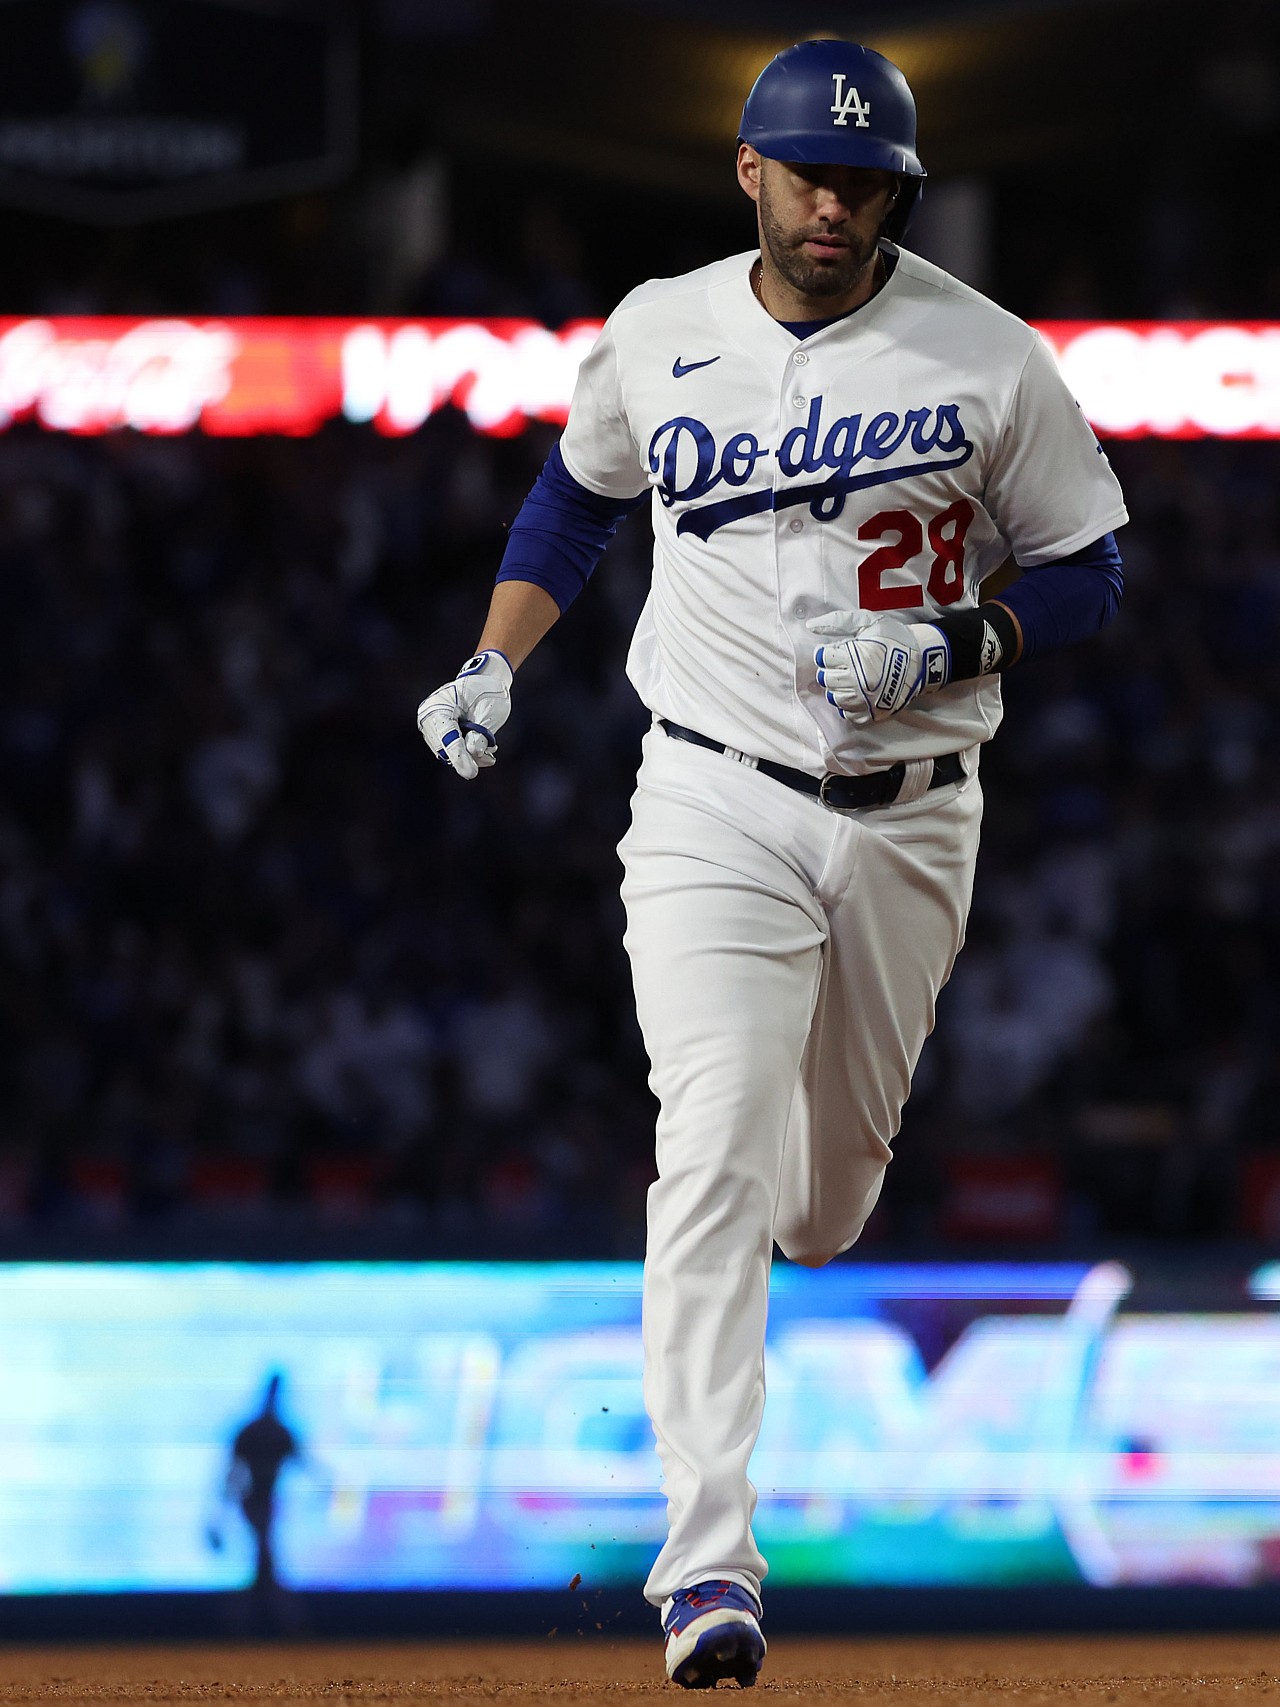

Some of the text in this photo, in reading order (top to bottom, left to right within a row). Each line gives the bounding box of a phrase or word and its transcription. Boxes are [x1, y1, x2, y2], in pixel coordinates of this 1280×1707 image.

[830, 73, 871, 128] LA
[648, 396, 973, 522] Dodgers
[857, 499, 974, 612] 28
[881, 653, 904, 707] Franklin
